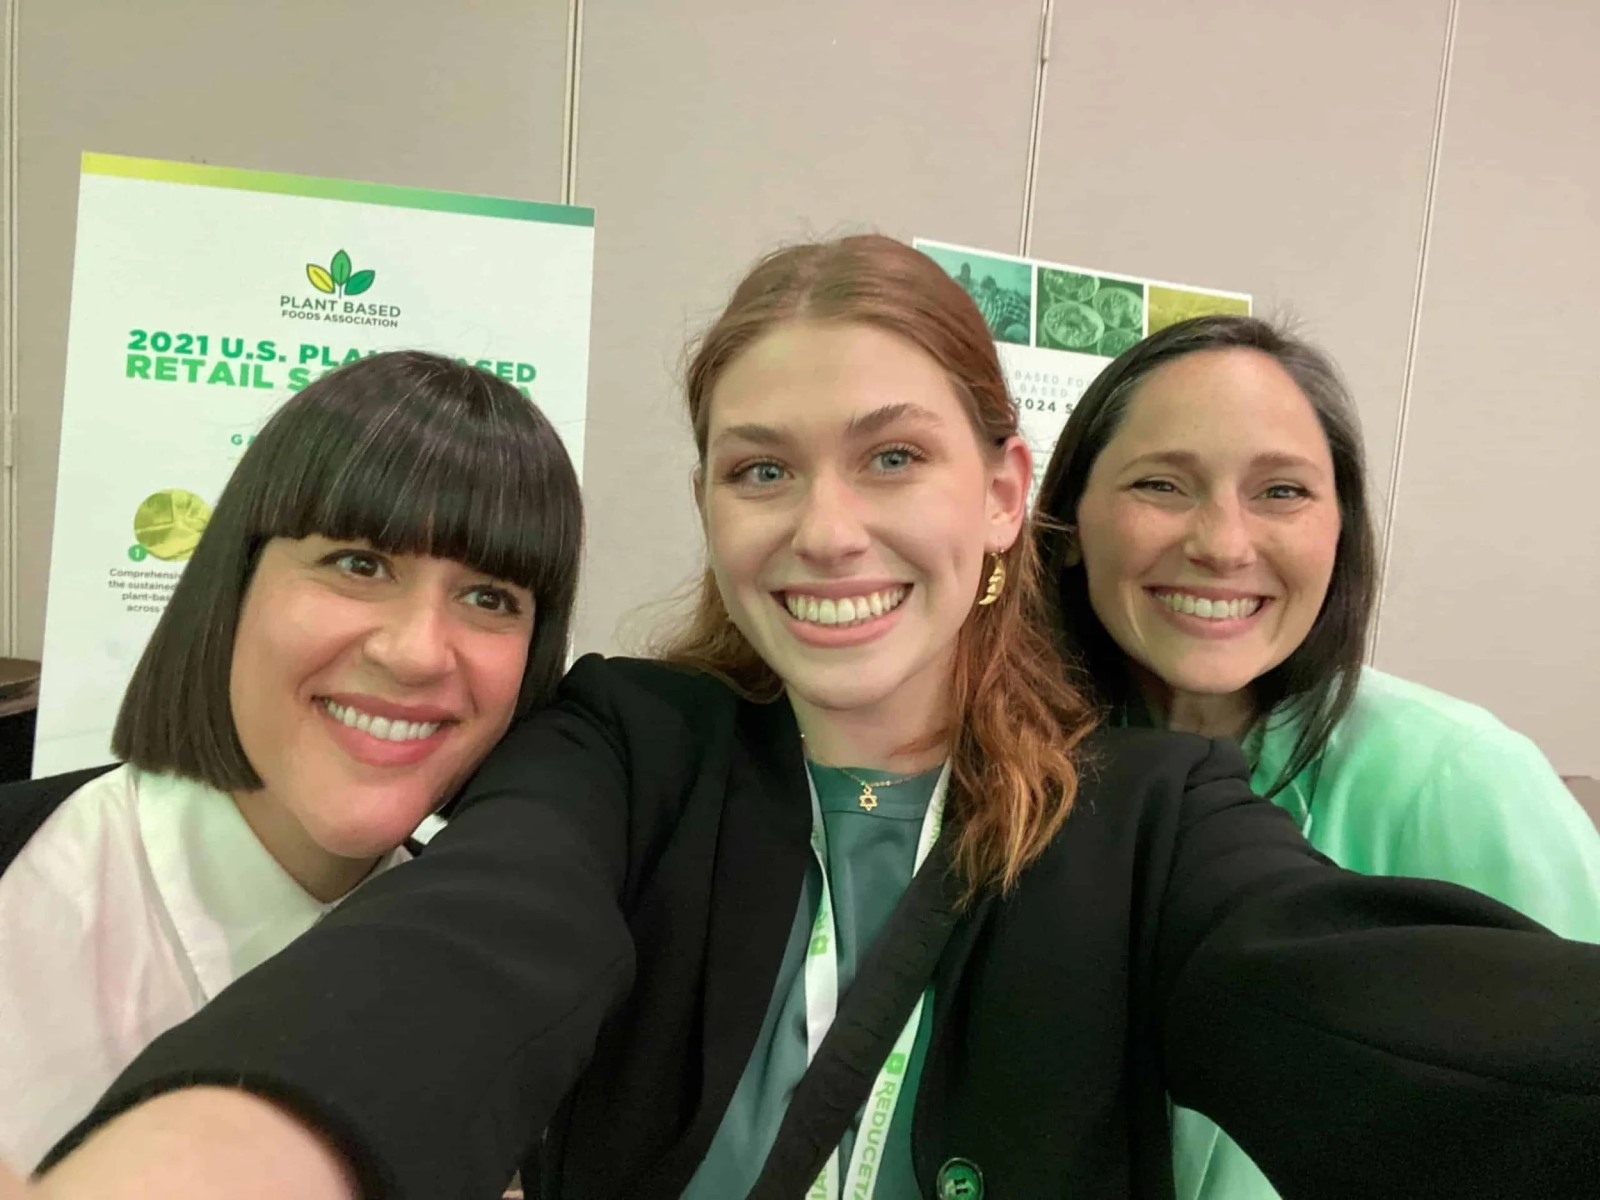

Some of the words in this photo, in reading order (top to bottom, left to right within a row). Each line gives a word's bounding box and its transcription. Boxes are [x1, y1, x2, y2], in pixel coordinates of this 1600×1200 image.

[280, 295, 338, 312] PLANT
[343, 301, 401, 318] BASED
[281, 309, 321, 321] FOODS
[323, 313, 399, 328] ASSOCIATION
[127, 329, 209, 356] 2021
[220, 337, 287, 363] U.S.
[299, 343, 377, 367] PLA
[125, 353, 275, 389] RETAIL
[1014, 397, 1057, 413] 2024
[108, 580, 126, 588] the
[126, 604, 161, 613] across
